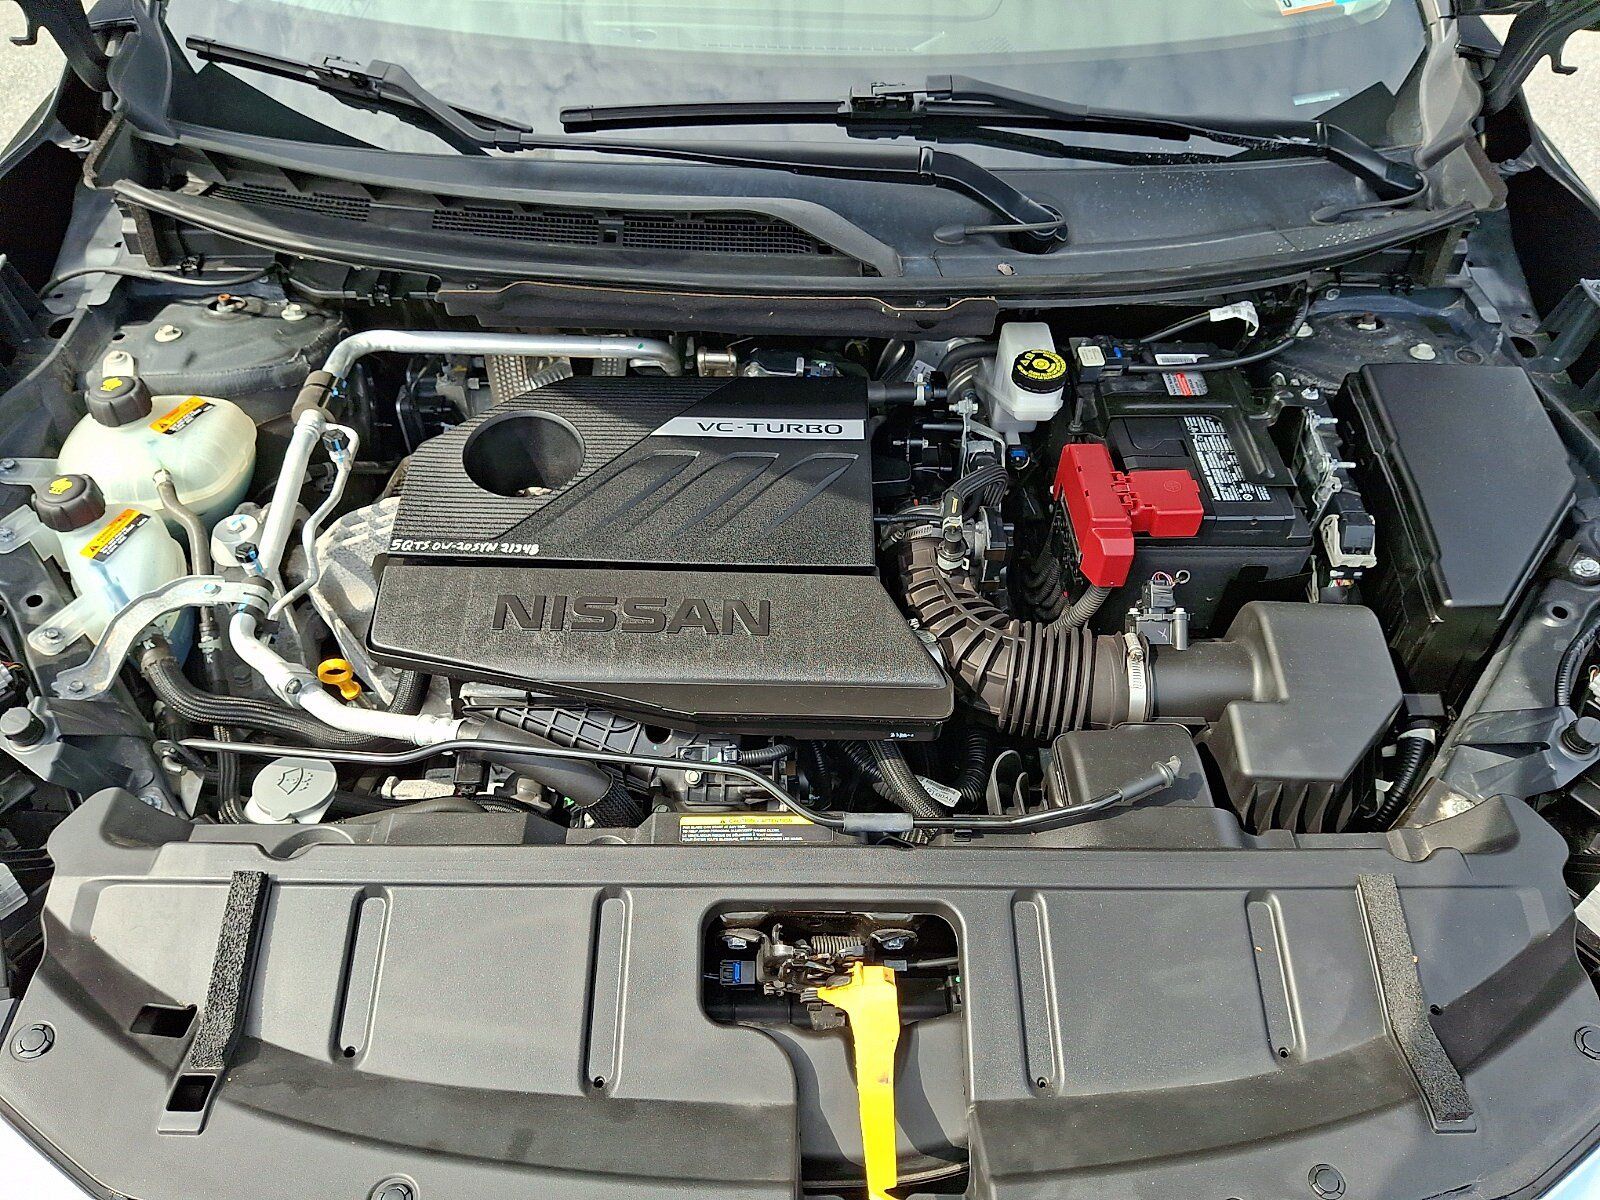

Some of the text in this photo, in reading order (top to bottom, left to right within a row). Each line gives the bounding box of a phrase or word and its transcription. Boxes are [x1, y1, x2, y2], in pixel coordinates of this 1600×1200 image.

[697, 422, 843, 435] VC-TURBO
[389, 539, 431, 551] 5QTS
[491, 594, 771, 636] NISSAN
